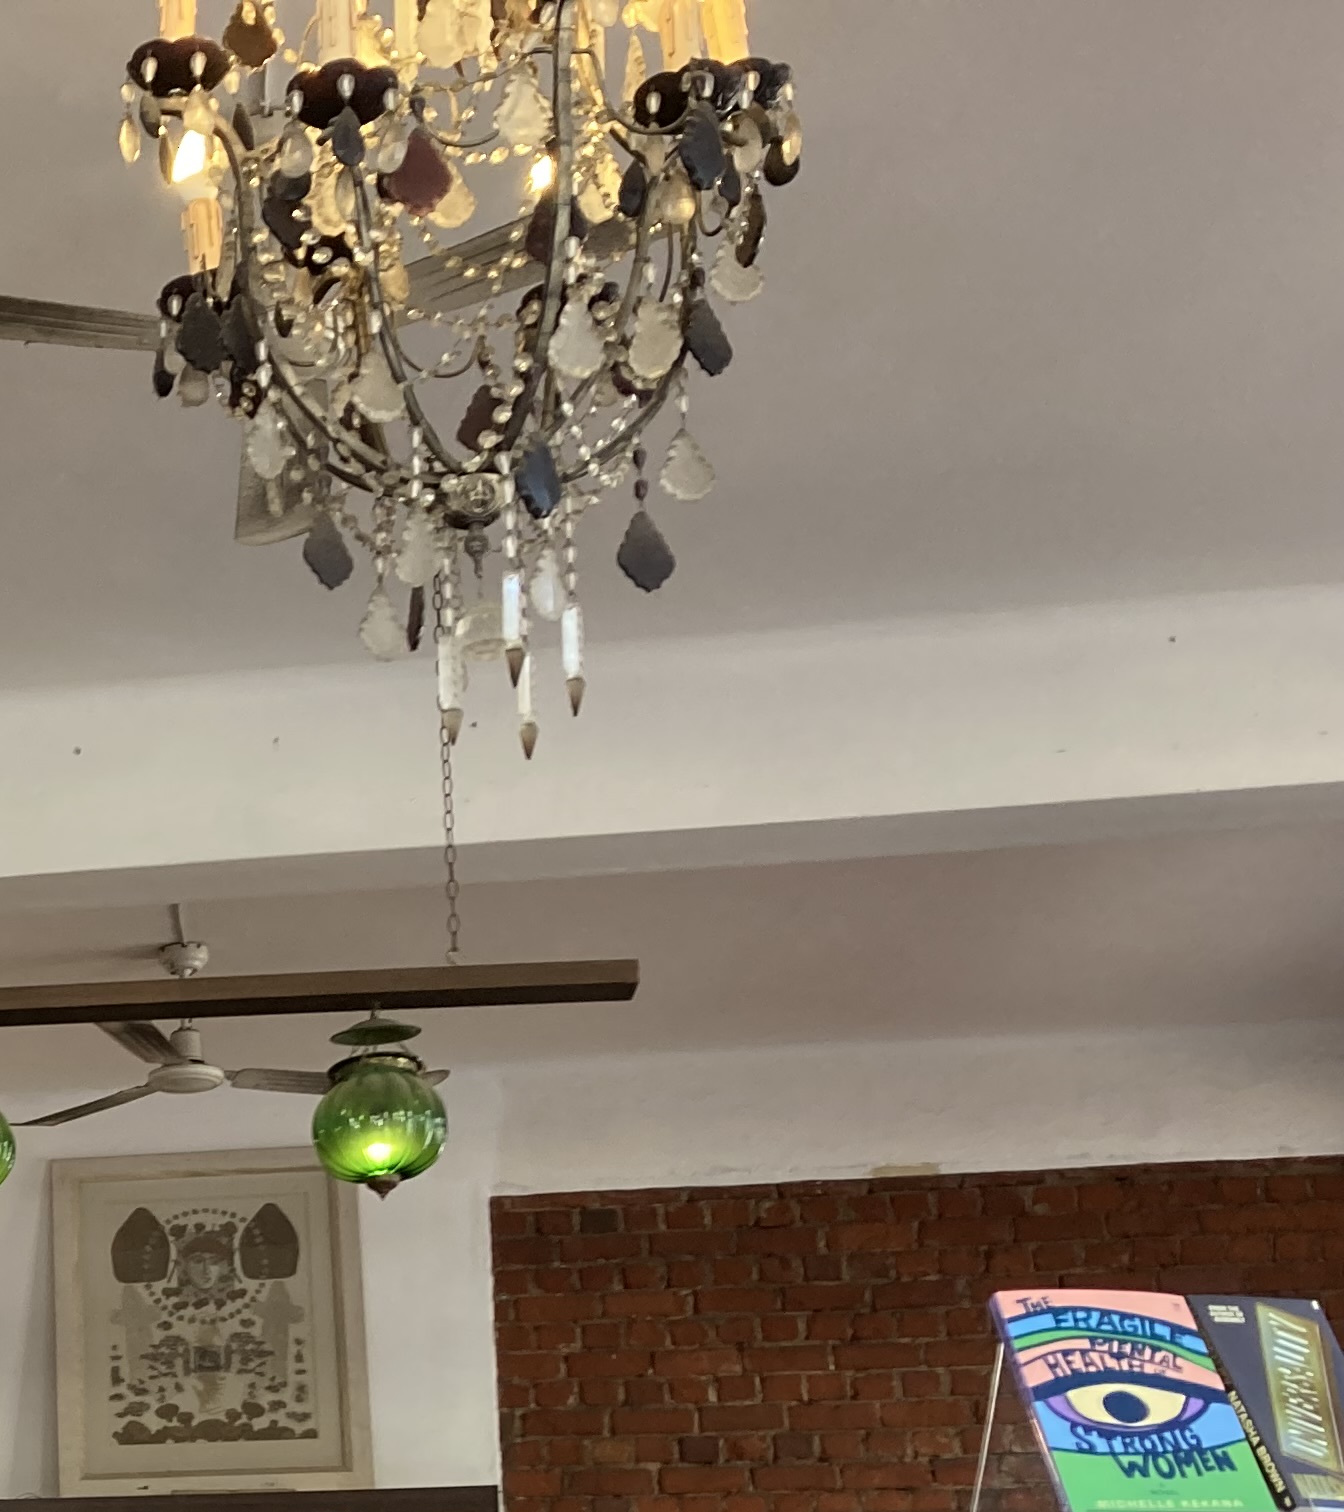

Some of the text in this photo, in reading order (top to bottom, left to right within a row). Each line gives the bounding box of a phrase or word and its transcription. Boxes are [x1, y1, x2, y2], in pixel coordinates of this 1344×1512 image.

[1016, 1295, 1053, 1313] THE
[1054, 1309, 1185, 1344] FRAGILE
[1042, 1349, 1145, 1378] HEALTH
[1070, 1422, 1201, 1455] STRONG
[1227, 1390, 1287, 1494] NATASHA BROWN
[1113, 1450, 1239, 1481] WOMEN
[1096, 1499, 1244, 1510] MICHELLE KEKANA
